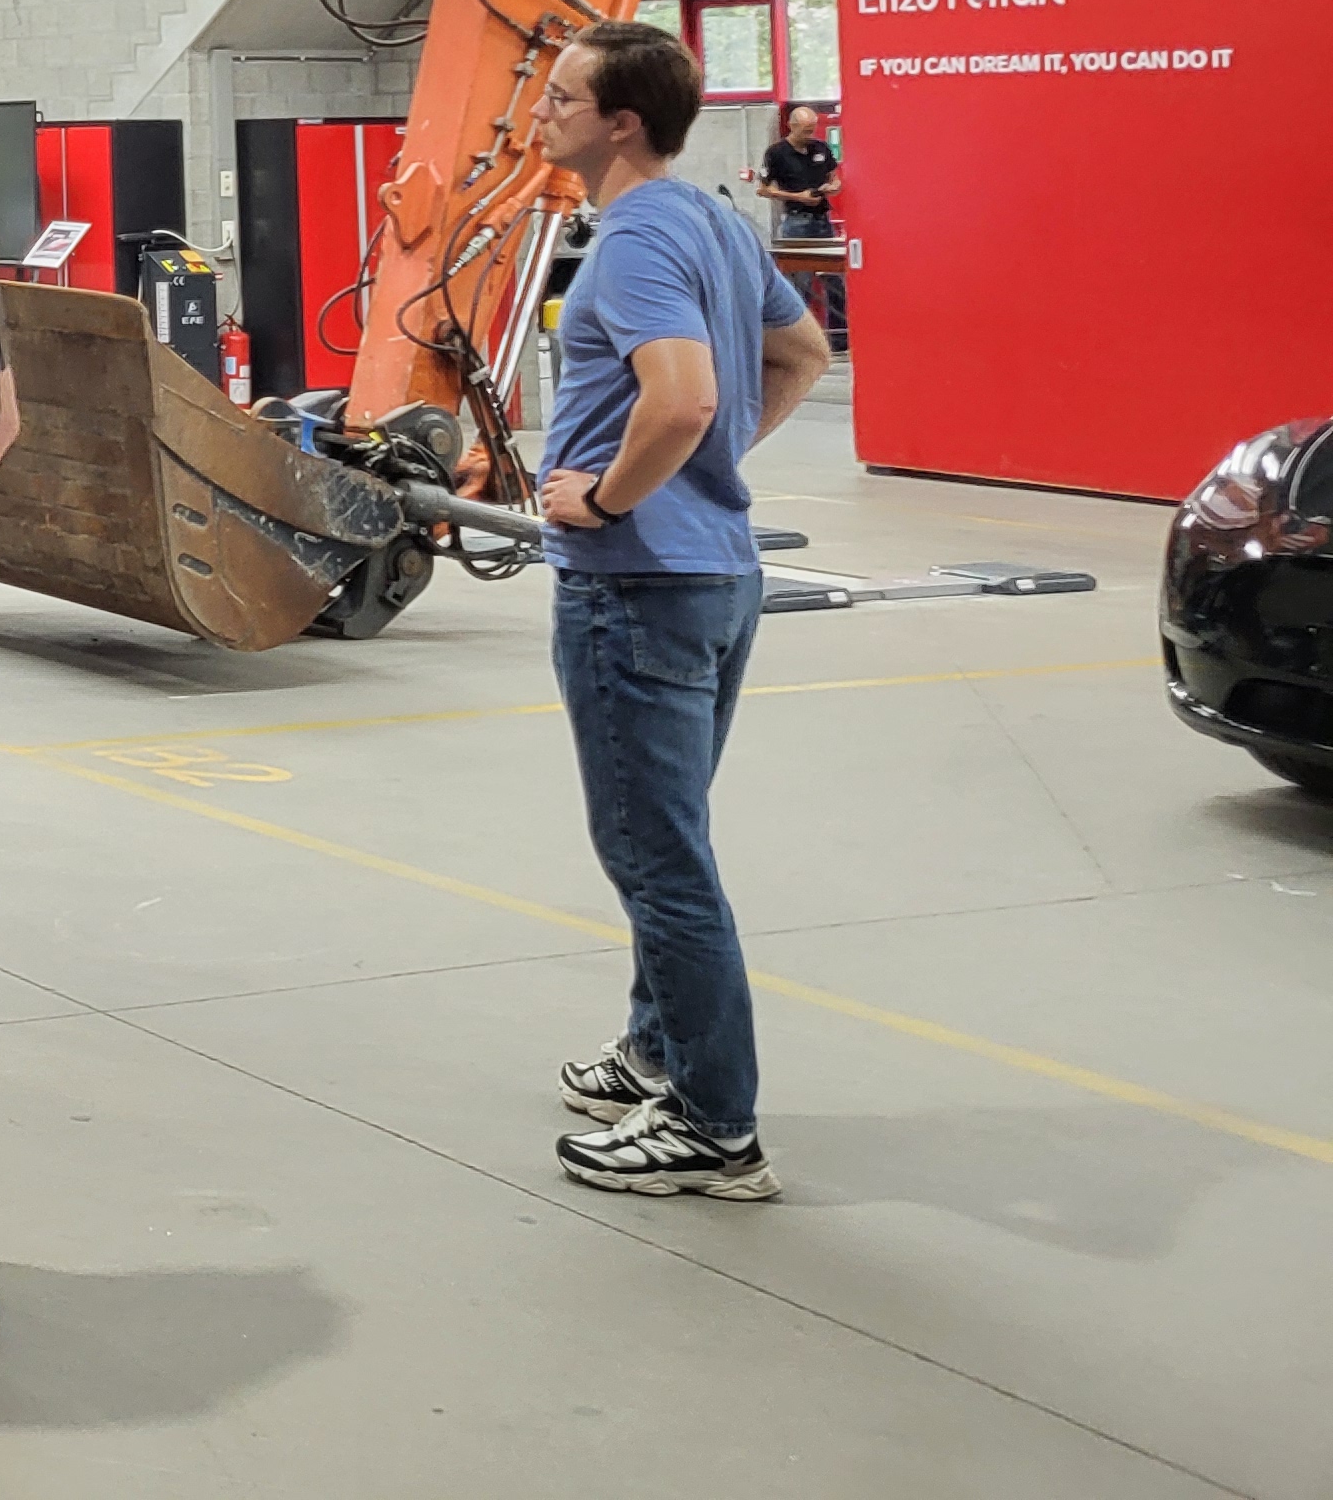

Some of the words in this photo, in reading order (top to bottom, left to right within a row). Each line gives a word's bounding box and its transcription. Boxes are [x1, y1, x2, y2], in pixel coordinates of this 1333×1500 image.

[860, 59, 877, 76] IF
[880, 57, 921, 75] YOU
[924, 56, 966, 75] CAN
[969, 54, 1040, 74] DREAM
[1044, 53, 1068, 74] IT,
[1070, 52, 1117, 71] YOU
[1121, 51, 1168, 70] CAN
[1172, 50, 1208, 69] DO
[1212, 49, 1233, 69] IT
